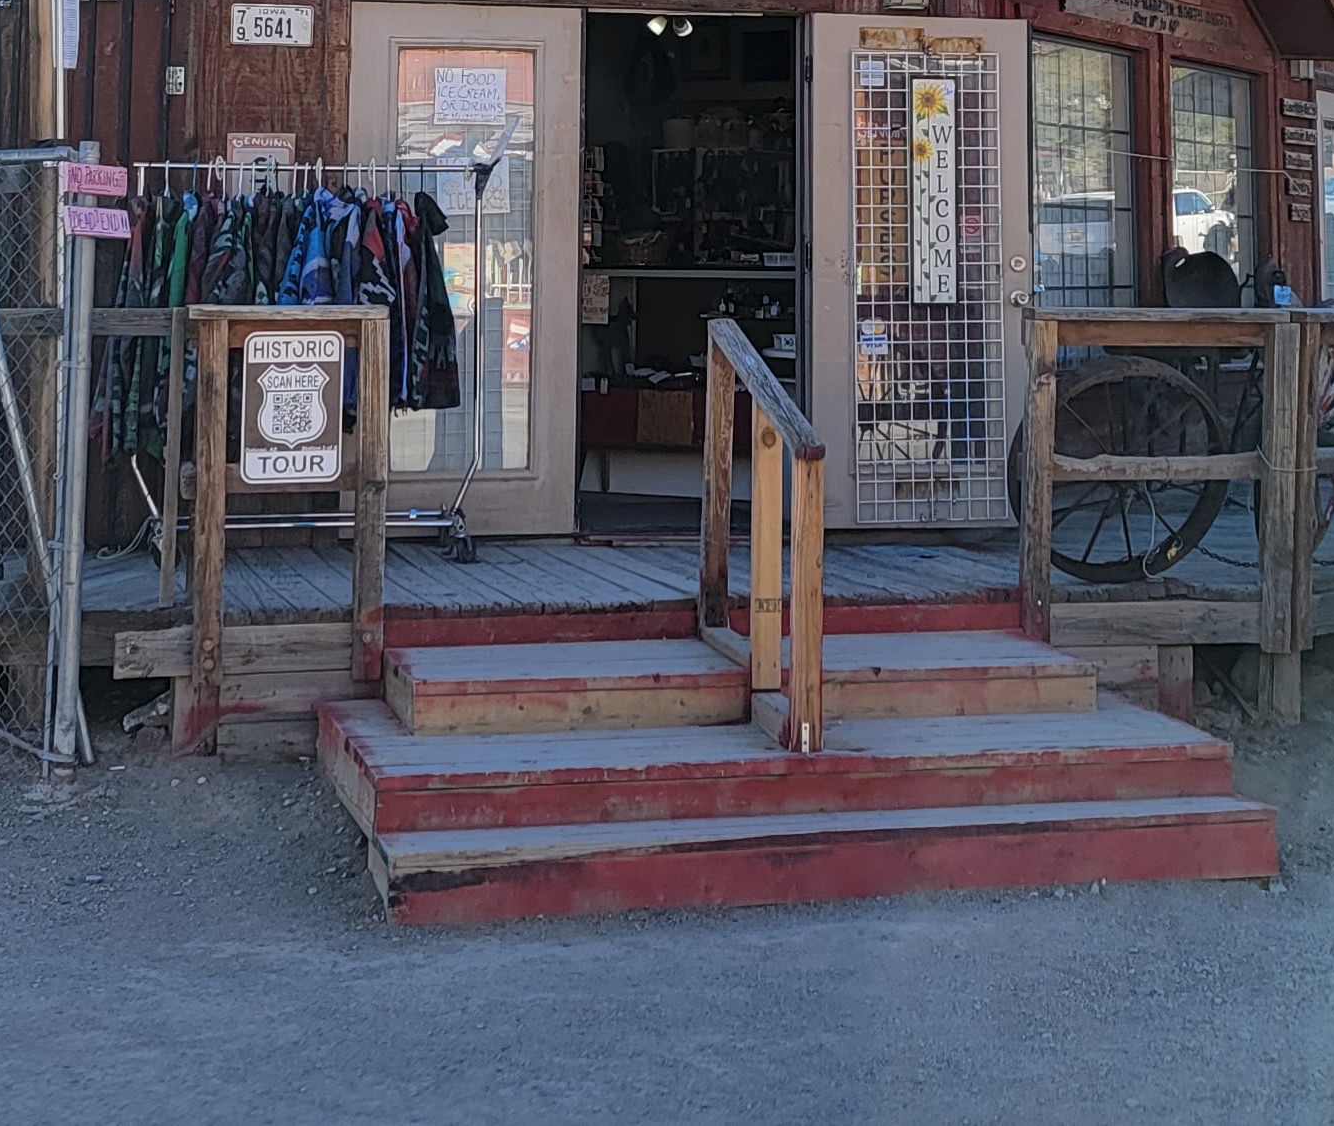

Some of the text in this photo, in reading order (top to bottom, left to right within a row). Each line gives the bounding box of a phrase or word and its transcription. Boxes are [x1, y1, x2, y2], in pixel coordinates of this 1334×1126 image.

[254, 17, 293, 39] 5641
[437, 69, 454, 83] NO
[438, 86, 456, 98] ICE
[441, 100, 504, 113] OR DRINKS
[71, 167, 83, 183] NO
[932, 125, 953, 294] WELCOME
[253, 339, 335, 359] HISTORIC
[267, 375, 319, 389] SCAN HERE
[258, 454, 324, 475] TOUR
